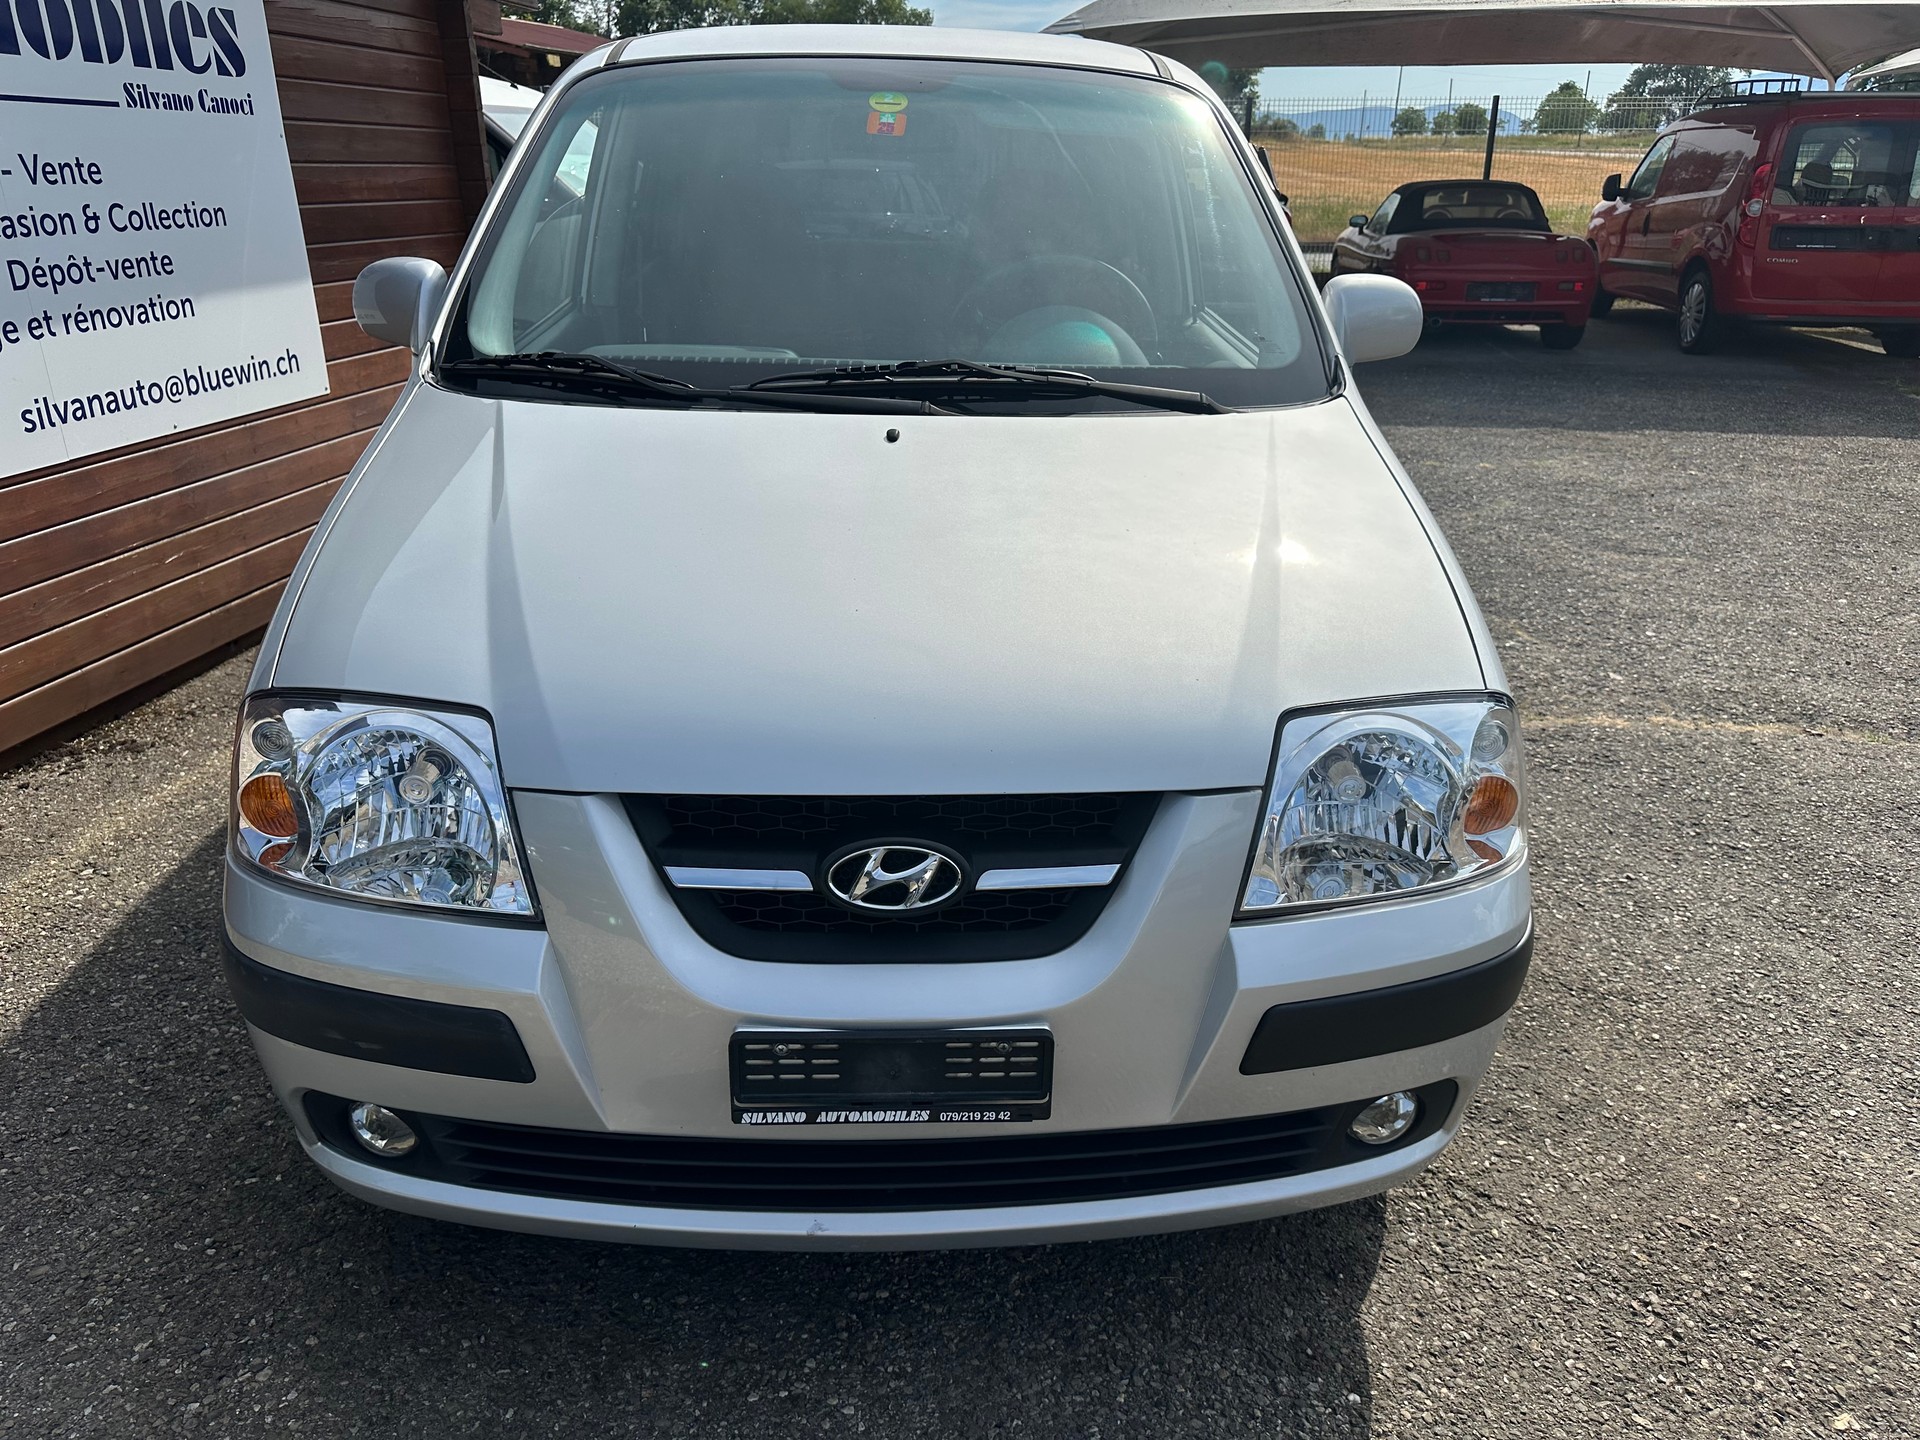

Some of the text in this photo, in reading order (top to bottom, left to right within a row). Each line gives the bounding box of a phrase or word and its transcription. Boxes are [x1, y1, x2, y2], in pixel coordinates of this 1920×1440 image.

[122, 82, 255, 116] Silvano Canoci
[17, 153, 103, 185] Vente
[0, 201, 228, 239] asion & Collection
[6, 250, 175, 295] Dépôt-vente
[27, 310, 57, 341] et
[62, 294, 196, 335] rénovation
[20, 348, 301, 433] silvanauto@bluewin.ch
[741, 1110, 1011, 1124] SILVANO AUTOMOBILES 079/219 29 42
